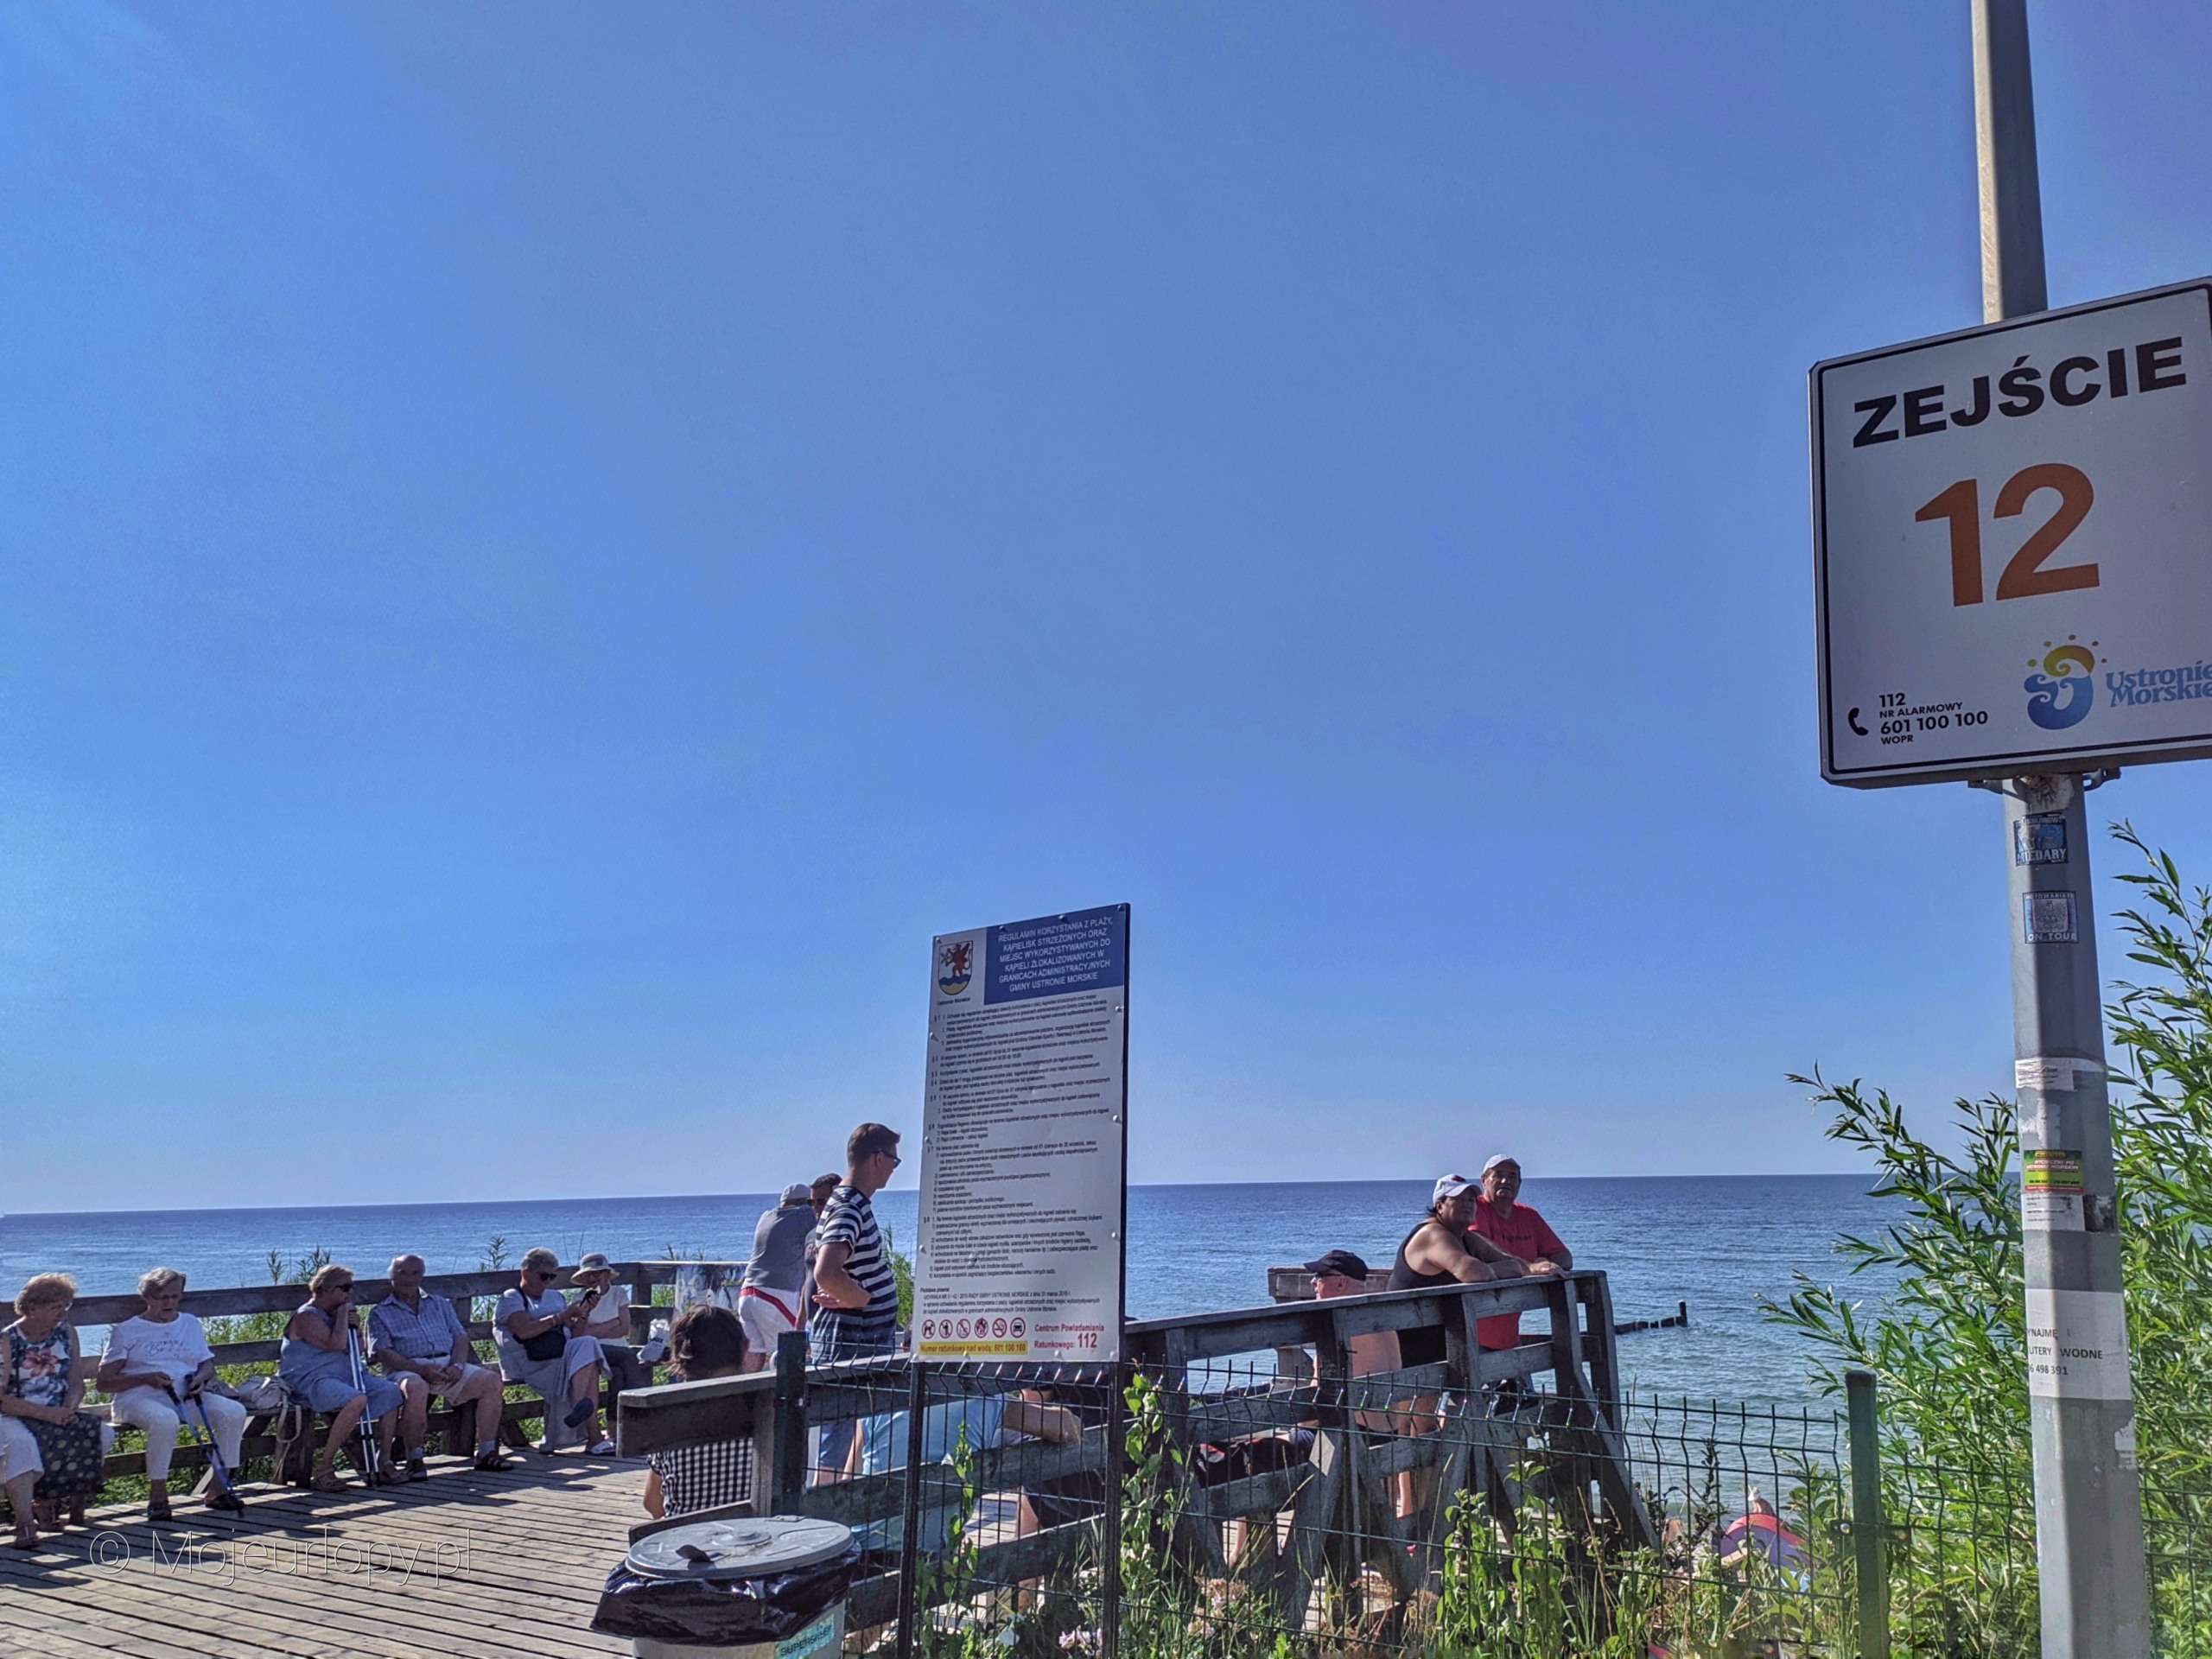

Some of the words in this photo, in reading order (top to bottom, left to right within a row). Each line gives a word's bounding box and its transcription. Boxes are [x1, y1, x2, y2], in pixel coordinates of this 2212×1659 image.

[1853, 336, 2187, 448] ZEJŚCIE
[1915, 463, 2100, 607] 12
[2106, 660, 2212, 690] Ustronie
[1879, 693, 1906, 708] 112
[2110, 682, 2212, 708] Morskie
[1879, 710, 1894, 719] NR
[1897, 702, 1962, 717] ALARMOWY
[1881, 719, 1910, 734] 601
[1916, 715, 1949, 731] 100
[1955, 711, 1988, 727] 100
[1881, 734, 1914, 745] WOPR
[998, 929, 1036, 942] REGULAMIN
[1037, 921, 1083, 935] KORZYSTANIA
[1003, 939, 1036, 952] KĄPIELISK
[1088, 928, 1107, 938] ORAZ
[2028, 933, 2044, 942] ON
[1000, 952, 1023, 963] MIEJSC
[1024, 940, 1099, 958] WYKORZYSTYWANYCH
[1100, 938, 1110, 947] DO
[999, 970, 1037, 983] GRANICACH
[1038, 960, 1110, 977] ADMINISTRACYJNYCH
[1005, 962, 1030, 973] KĄPIELI
[1031, 951, 1096, 969] ZLOKALIZOWANYCH
[1009, 982, 1030, 992] GMINY
[1032, 976, 1065, 987] USTRONIE
[1067, 971, 1099, 983] MORSKIE
[1034, 1324, 1059, 1332] Centrum
[1060, 1324, 1104, 1332] Powiadamiania
[1034, 1340, 1075, 1351] Ratunkowego:
[1078, 1332, 1097, 1348] 112
[2060, 1348, 2102, 1359] WODNE
[2036, 1365, 2049, 1374] 498
[2050, 1366, 2068, 1376] 391
